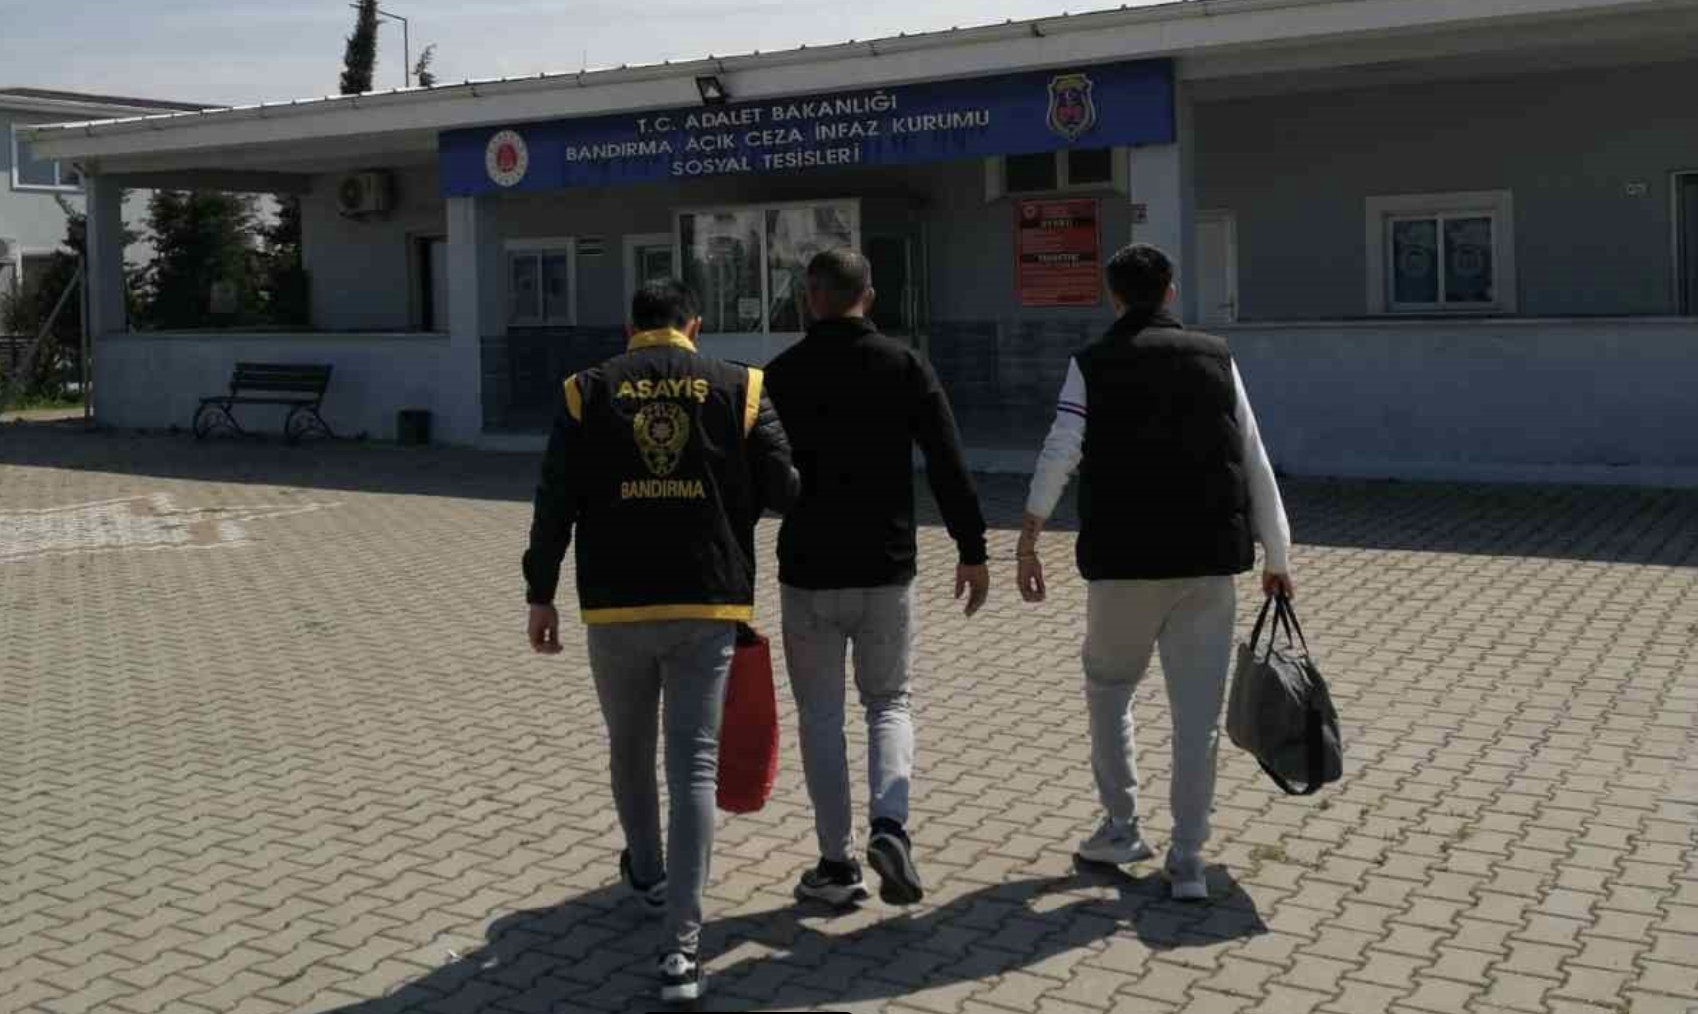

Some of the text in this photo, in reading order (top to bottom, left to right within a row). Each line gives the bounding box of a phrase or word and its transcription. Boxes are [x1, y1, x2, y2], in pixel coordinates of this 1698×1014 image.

[637, 90, 897, 133] T.C. ADALET BAKANLIĞI
[565, 109, 990, 162] BANDIRMA AÇIK CEZA İNFAZ KURUMU
[671, 142, 860, 176] SOSYAL TESİSLERİ
[616, 376, 709, 403] ASAYİŞ
[621, 480, 706, 499] BANDIRMA
